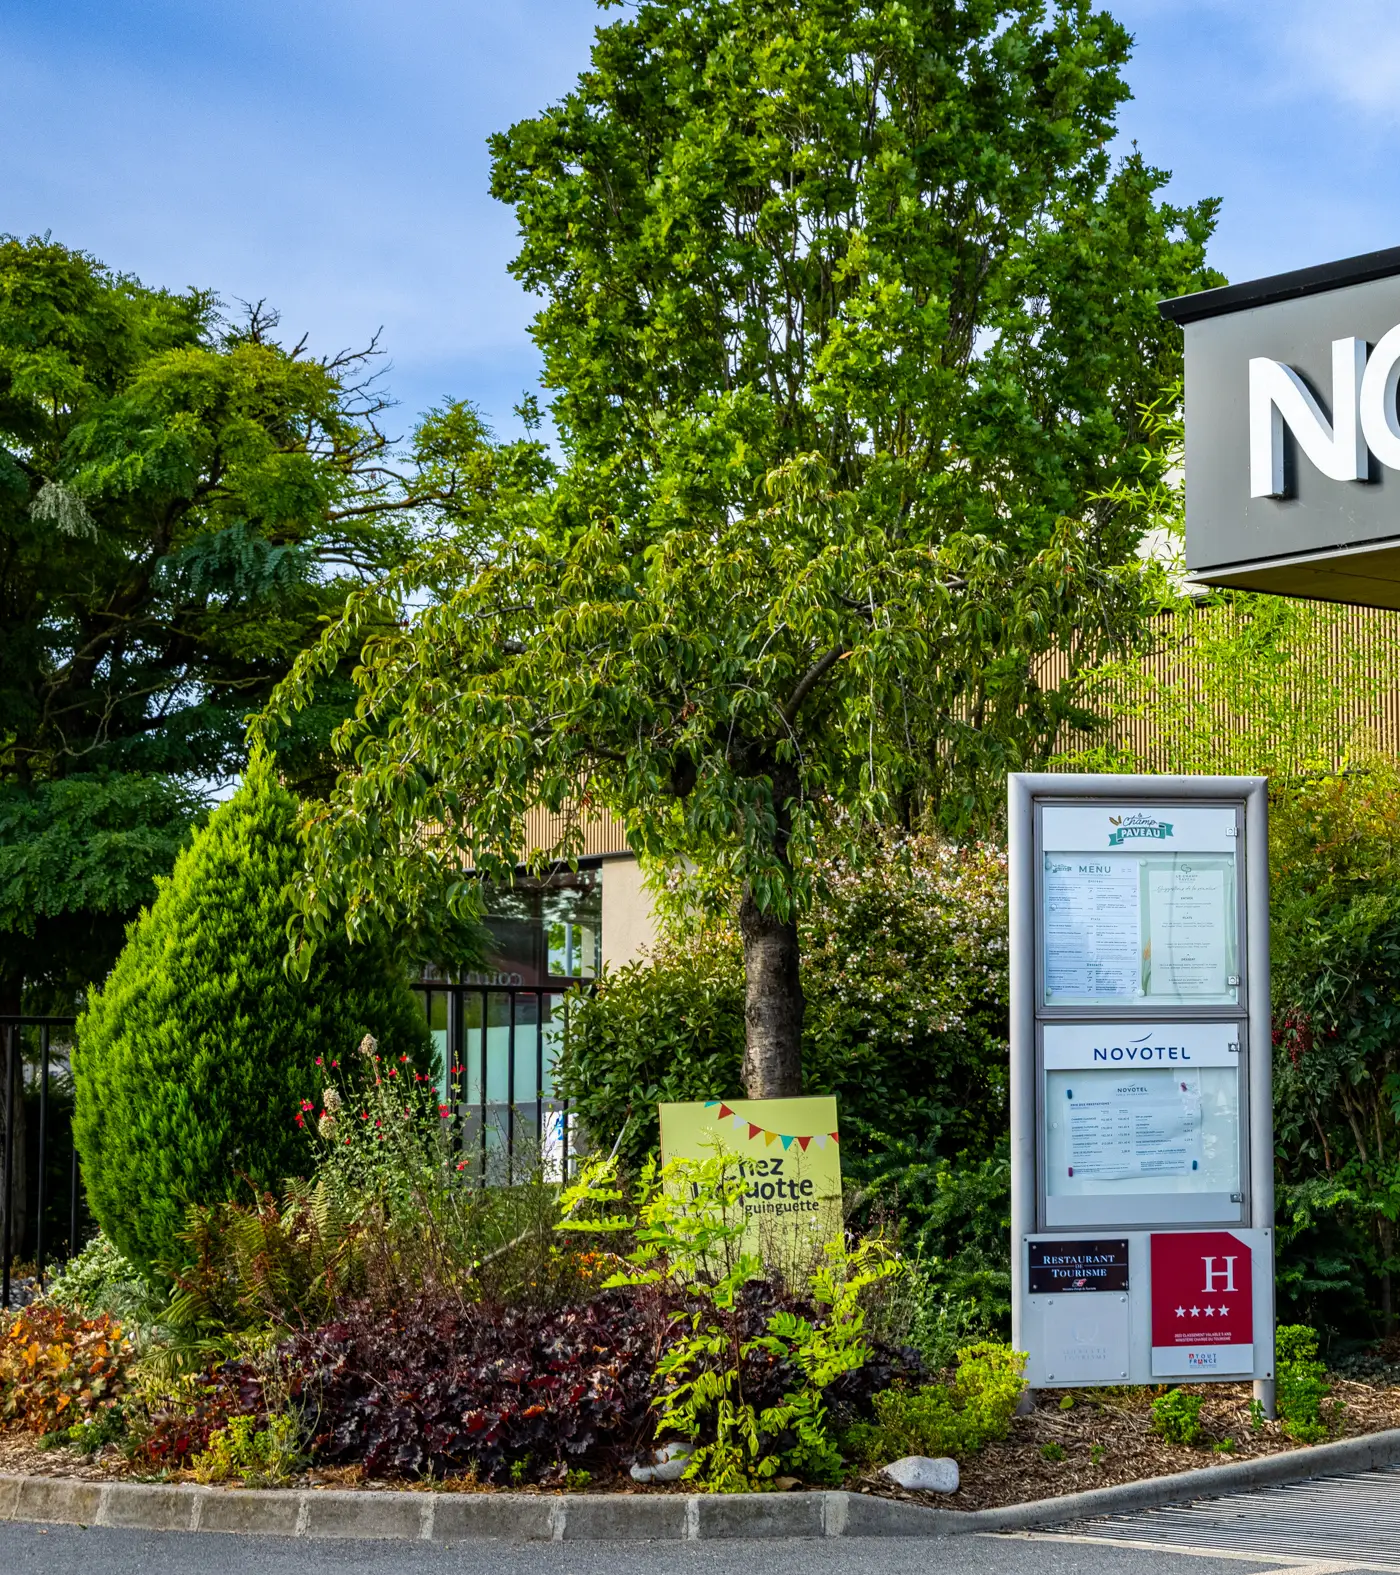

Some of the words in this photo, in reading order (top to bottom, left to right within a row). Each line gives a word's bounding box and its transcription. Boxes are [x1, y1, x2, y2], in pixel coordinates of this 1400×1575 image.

[1123, 815, 1158, 827] Champ
[1121, 828, 1161, 838] PAVEAU
[1078, 865, 1112, 874] MENU
[1093, 1046, 1191, 1061] NOVOTEL
[745, 1201, 819, 1217] guinguette
[1201, 1255, 1239, 1293] H
